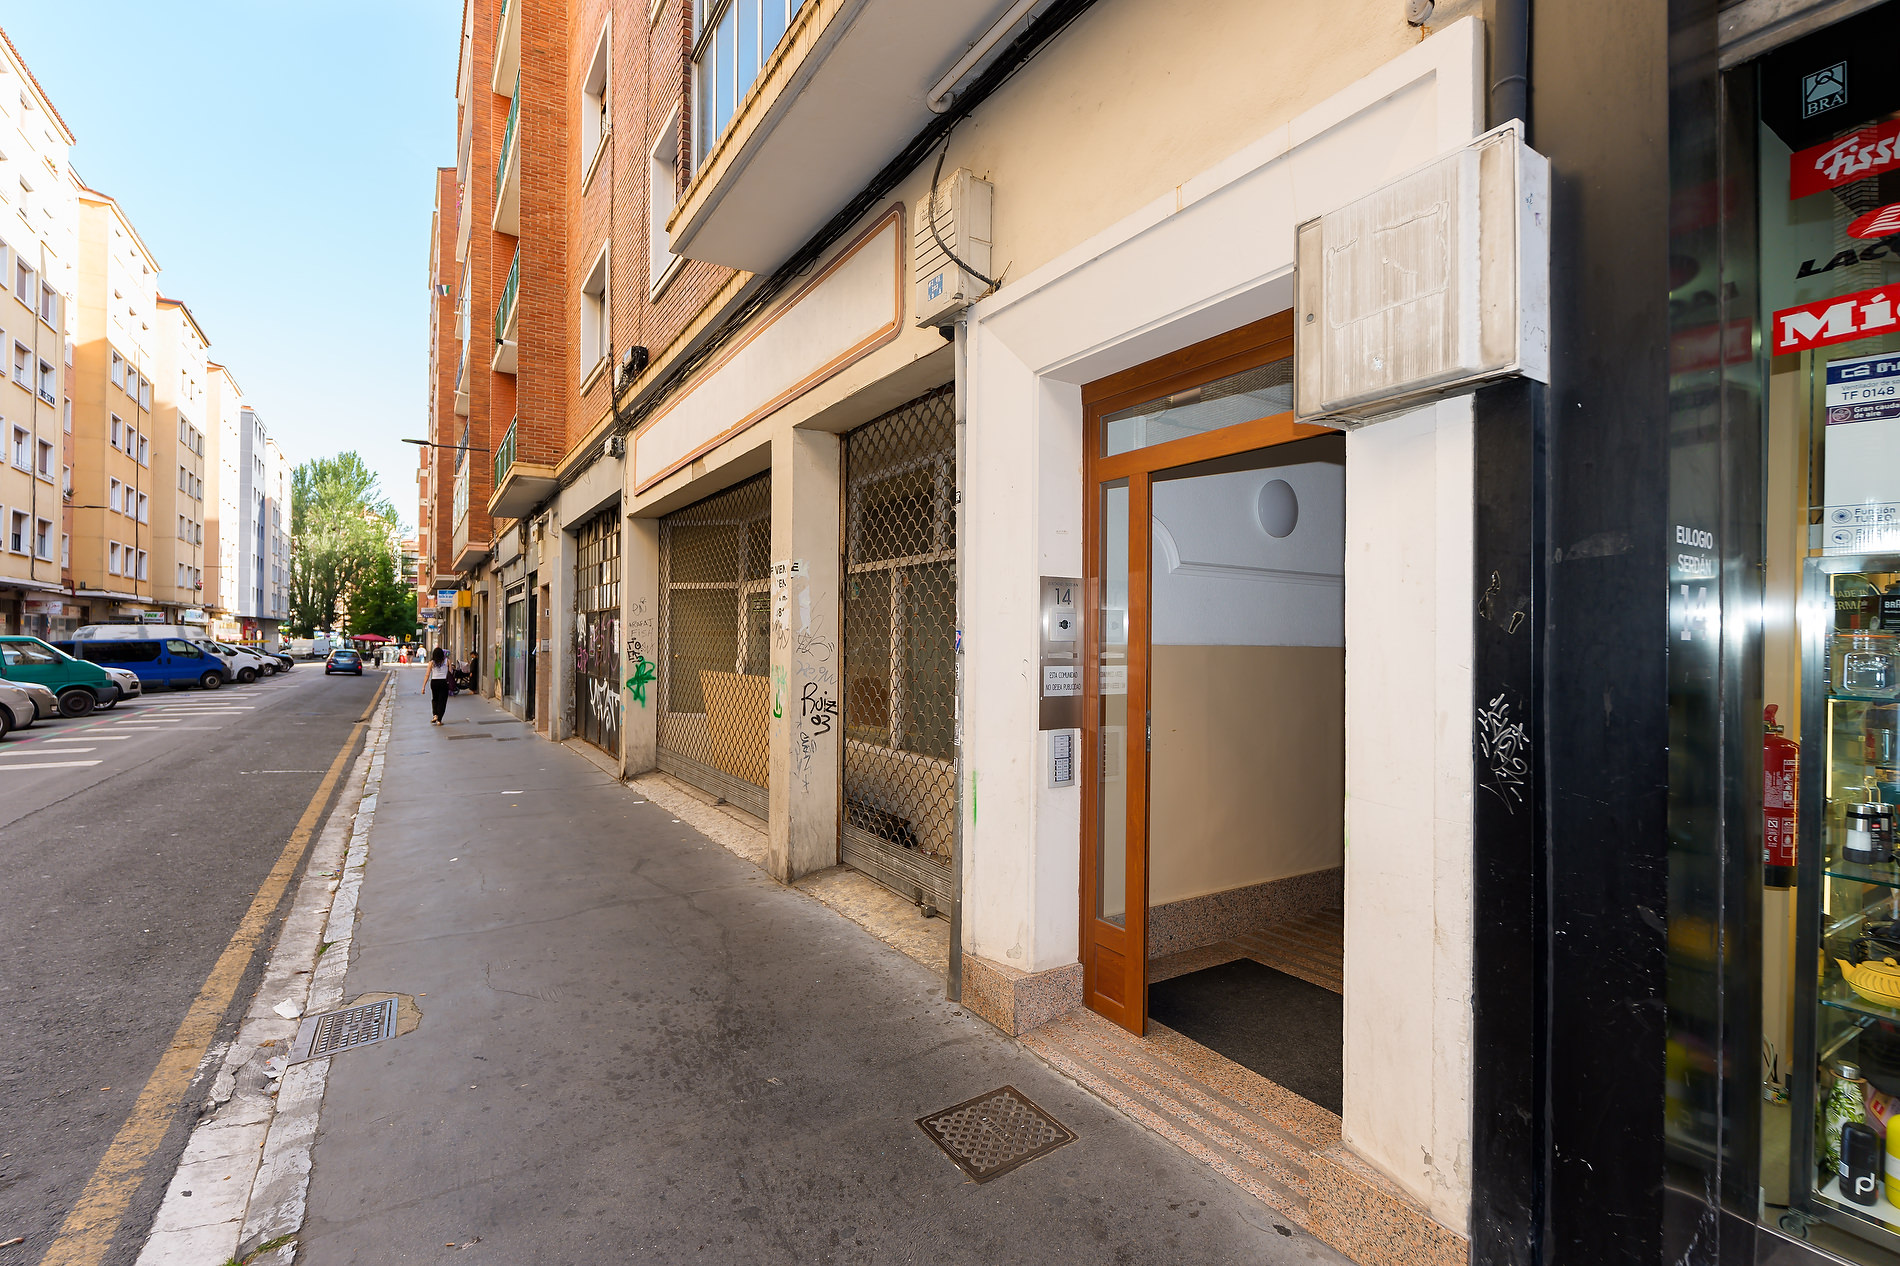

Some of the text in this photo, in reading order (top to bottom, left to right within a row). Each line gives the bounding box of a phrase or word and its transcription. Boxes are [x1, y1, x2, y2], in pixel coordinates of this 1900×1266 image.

[1807, 93, 1843, 115] BRA
[1841, 386, 1895, 400] TF 0148
[1676, 525, 1714, 550] EULOGIO
[1677, 553, 1712, 576] SERDÁN
[1055, 587, 1072, 605] 14
[1049, 671, 1058, 679] ESTA
